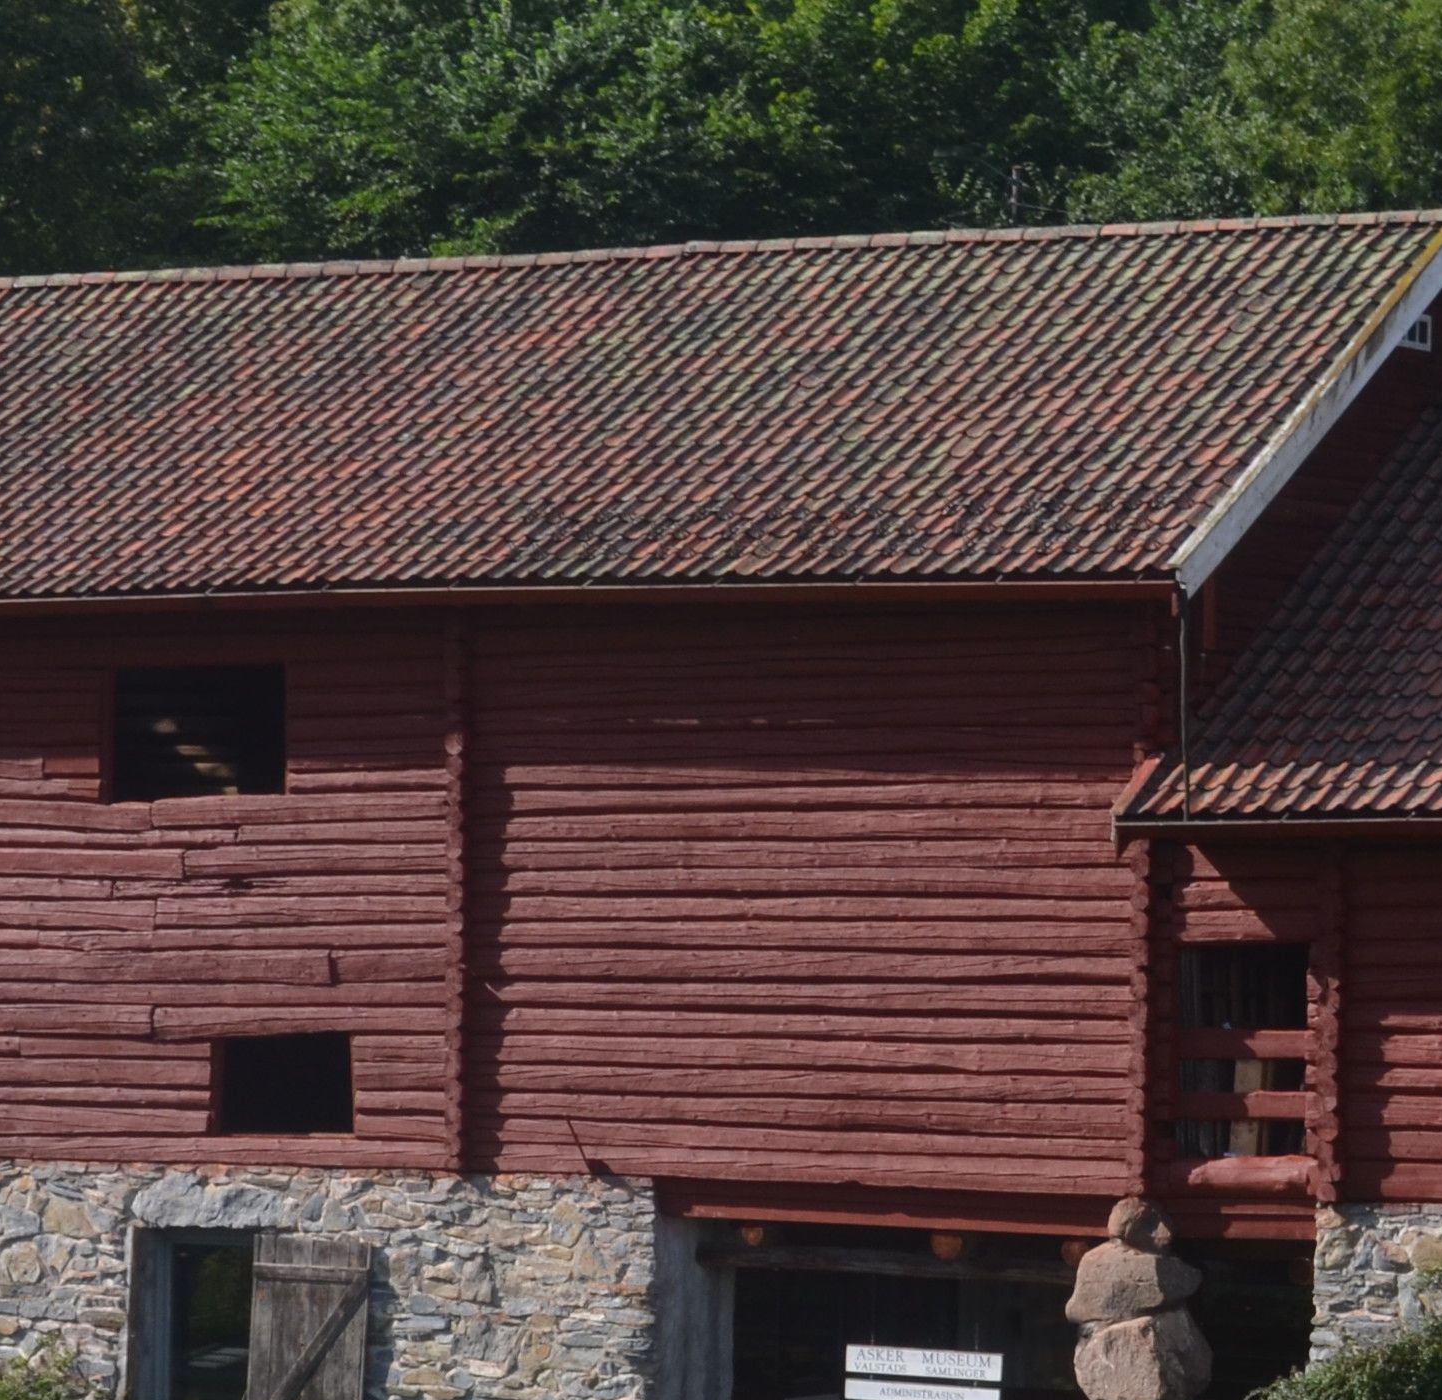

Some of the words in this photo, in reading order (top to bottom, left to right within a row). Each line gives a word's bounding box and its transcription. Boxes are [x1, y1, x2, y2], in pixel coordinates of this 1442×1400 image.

[856, 1348, 905, 1363] ASKER
[922, 1352, 991, 1369] MUSEUM
[854, 1362, 907, 1374] VALSTADS
[925, 1366, 987, 1379] SAMLINGER
